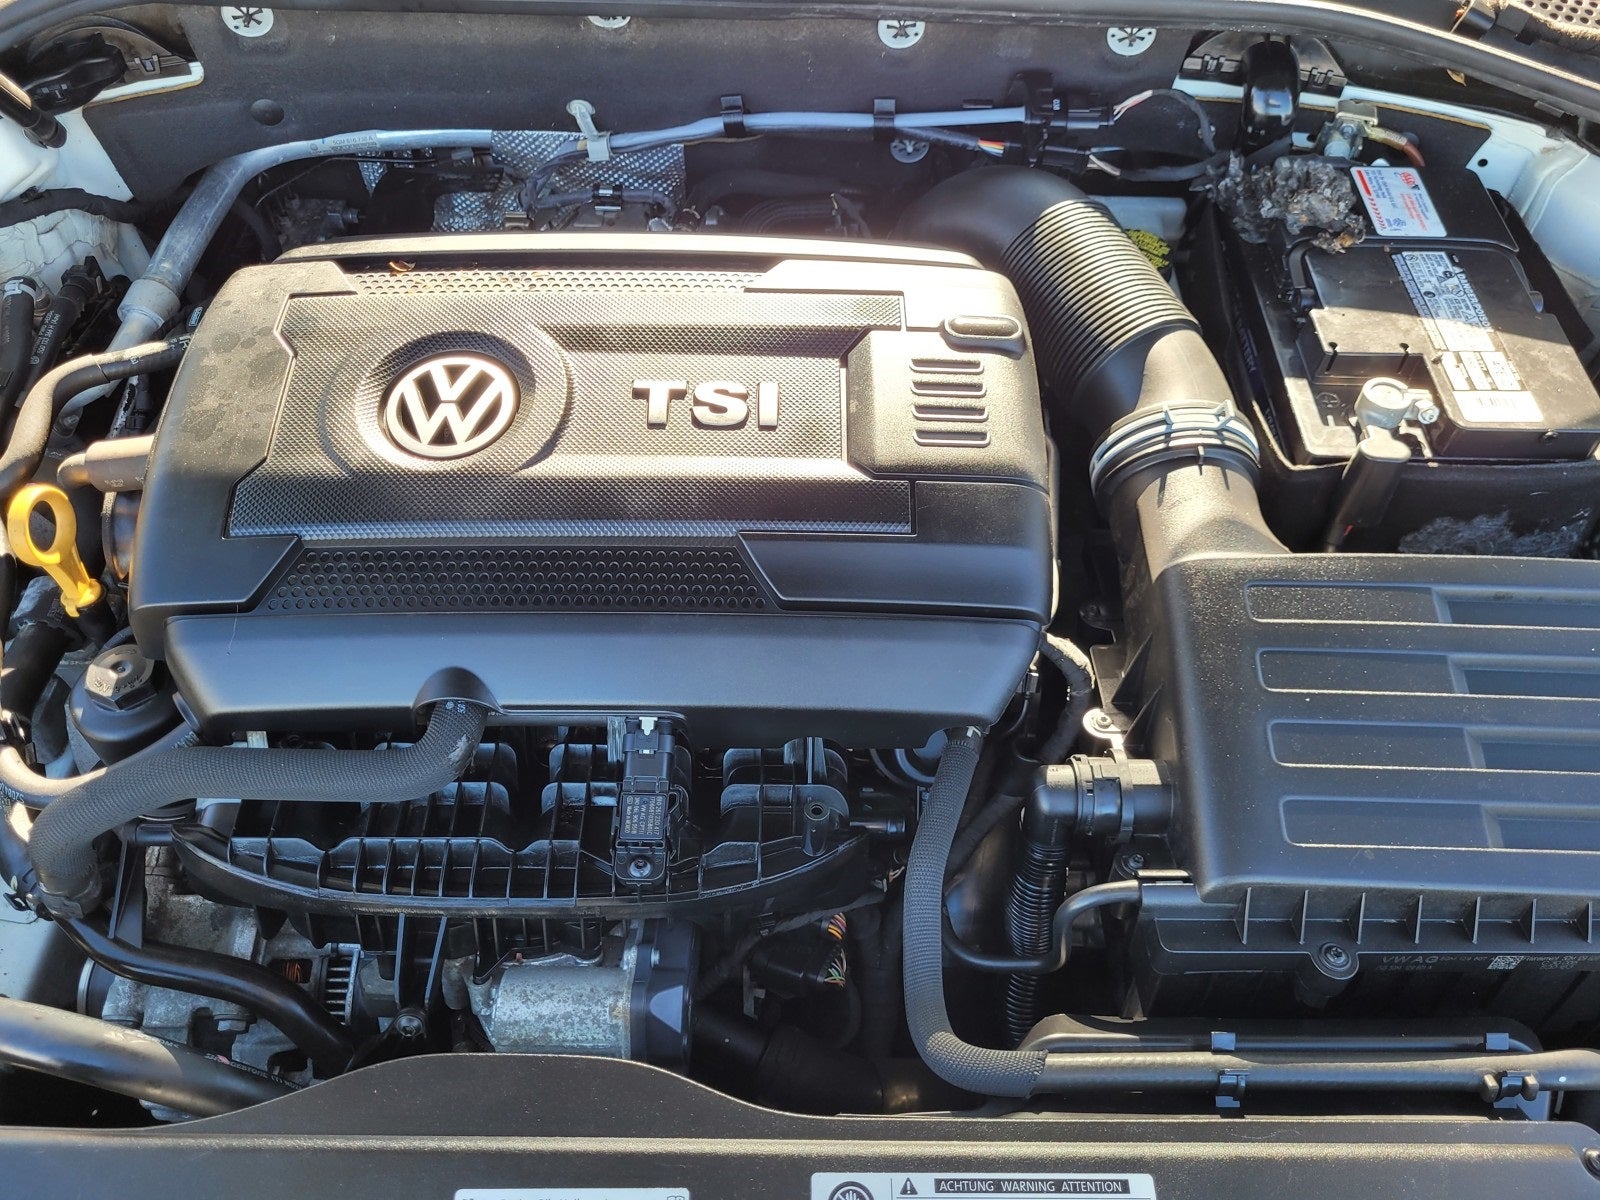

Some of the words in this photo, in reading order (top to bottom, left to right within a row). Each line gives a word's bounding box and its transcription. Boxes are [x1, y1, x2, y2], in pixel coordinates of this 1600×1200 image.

[632, 379, 781, 430] TSI
[939, 1180, 995, 1192] ACHTUNG
[1001, 1180, 1056, 1193] WARNING
[1061, 1180, 1123, 1193] ATTENTION
